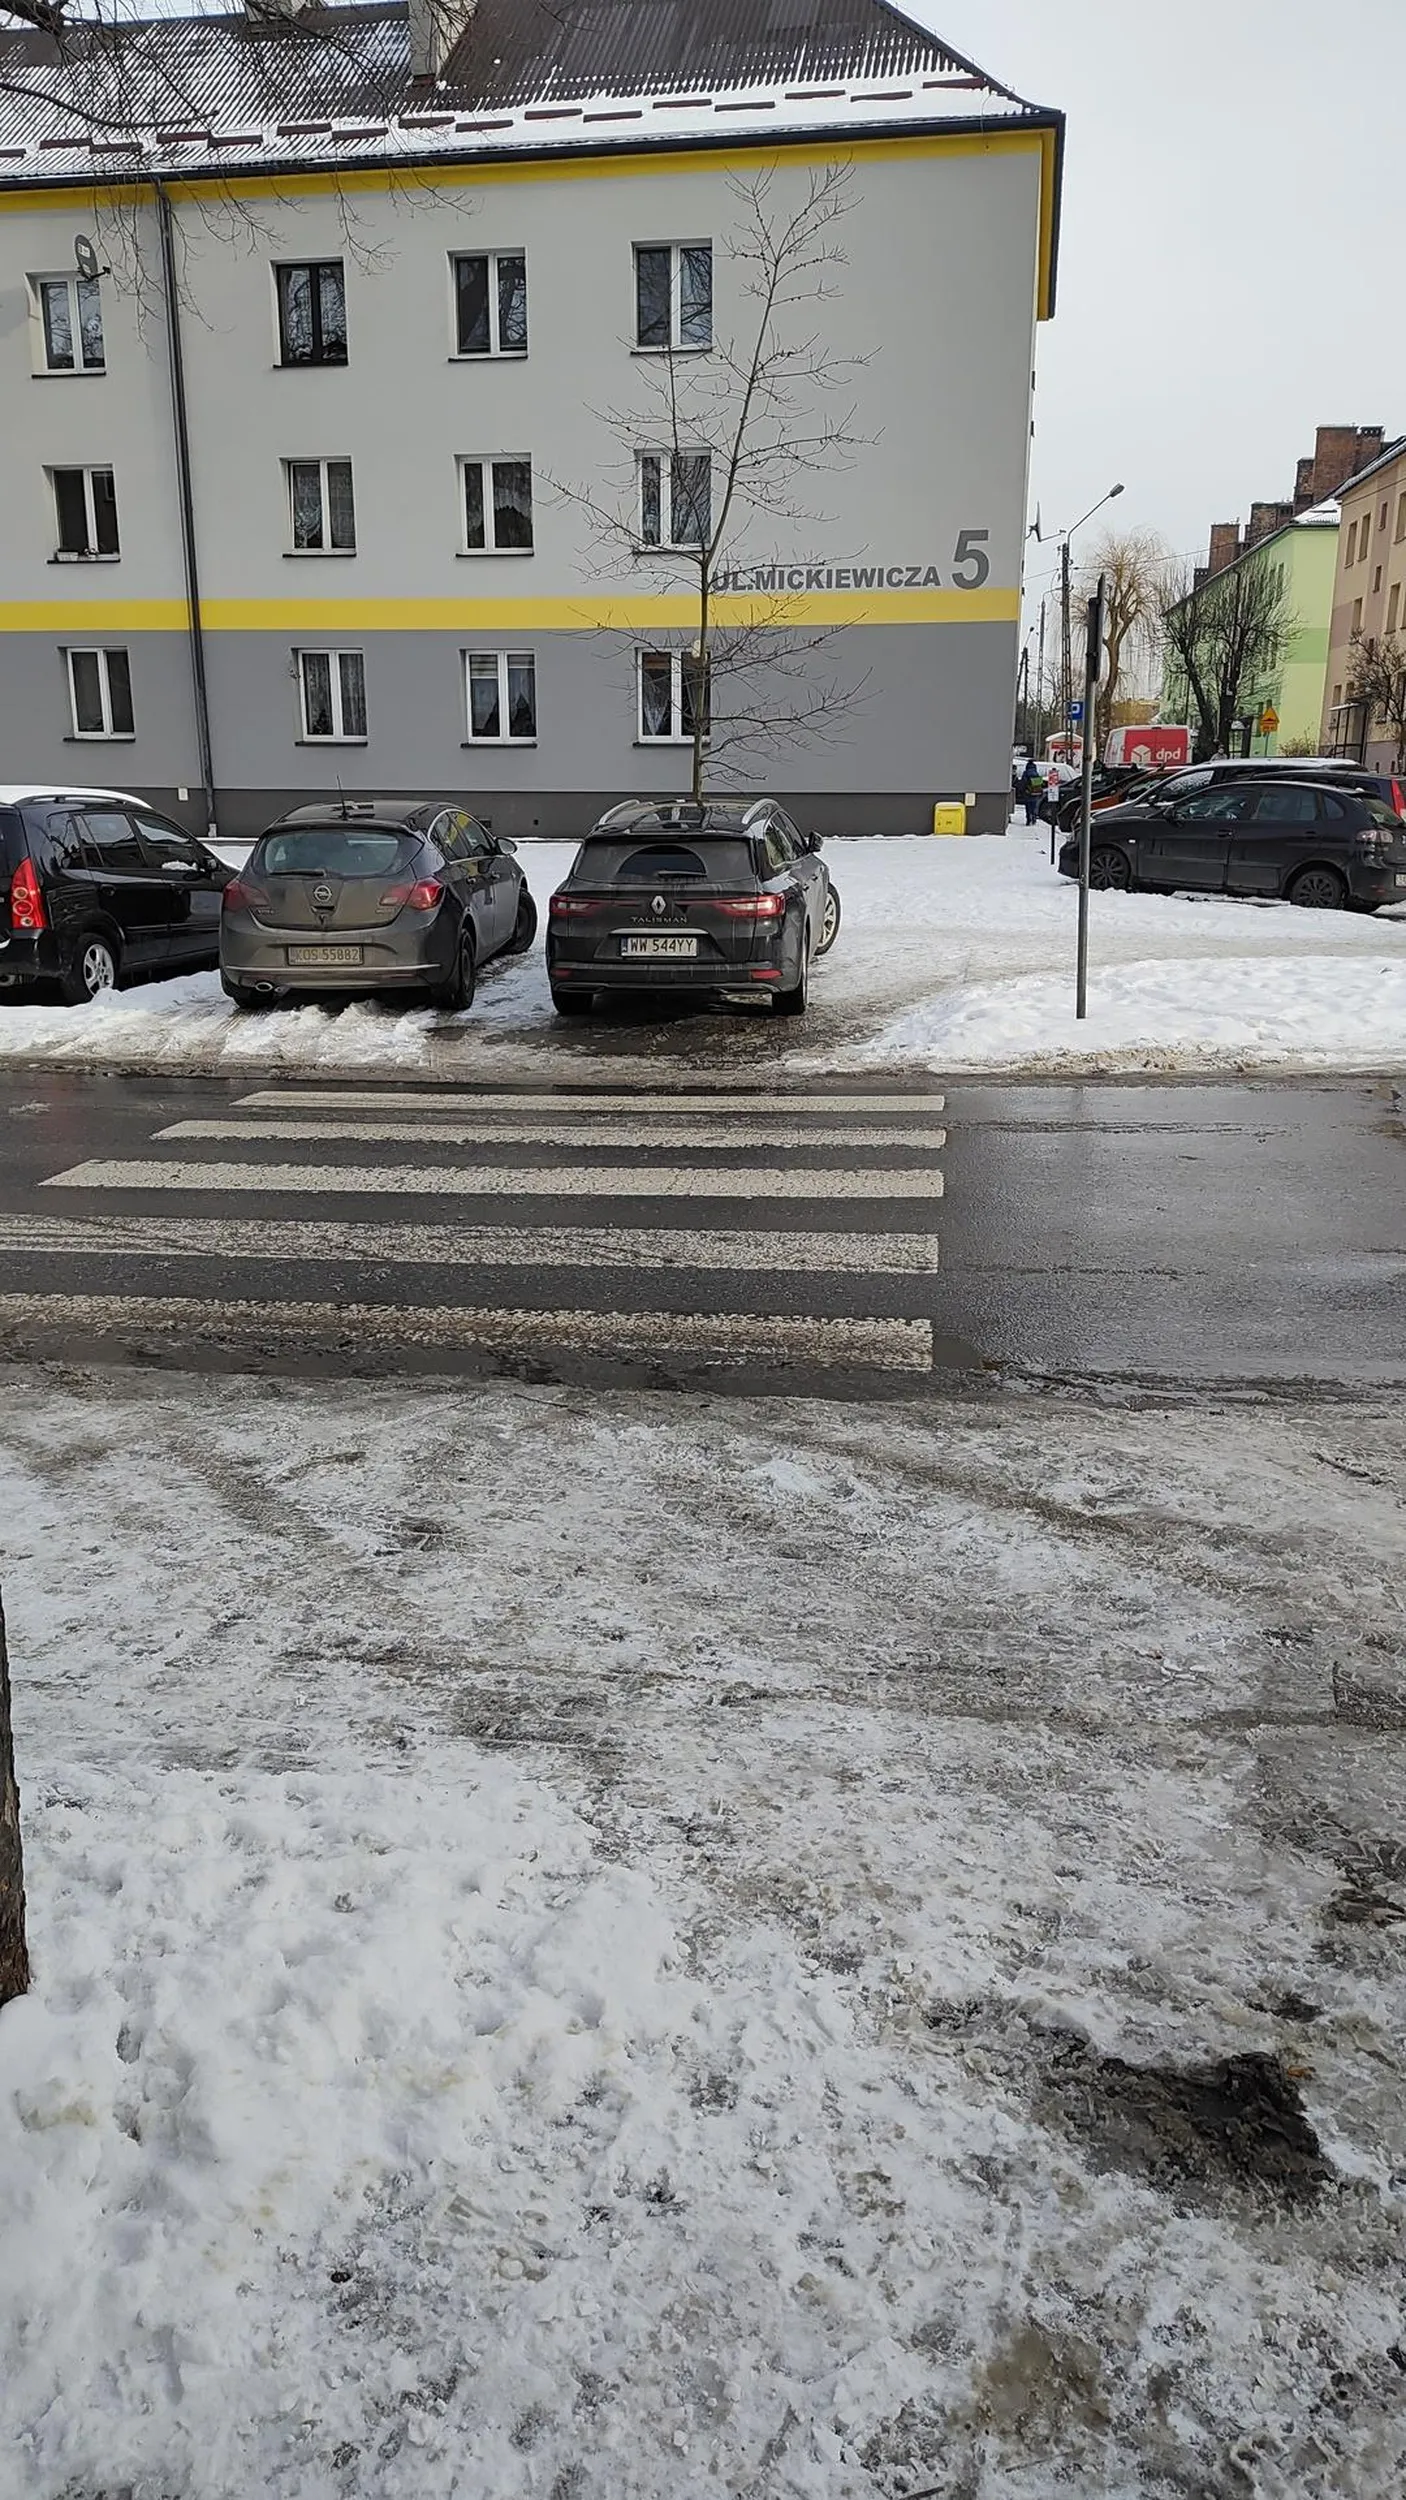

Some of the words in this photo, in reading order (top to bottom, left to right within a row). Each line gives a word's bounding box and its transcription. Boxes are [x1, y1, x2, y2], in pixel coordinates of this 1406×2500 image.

[952, 529, 990, 590] 5
[1156, 748, 1181, 764] dpd
[630, 939, 648, 952] WW
[653, 939, 693, 952] 544YY
[322, 949, 359, 961] 55882
